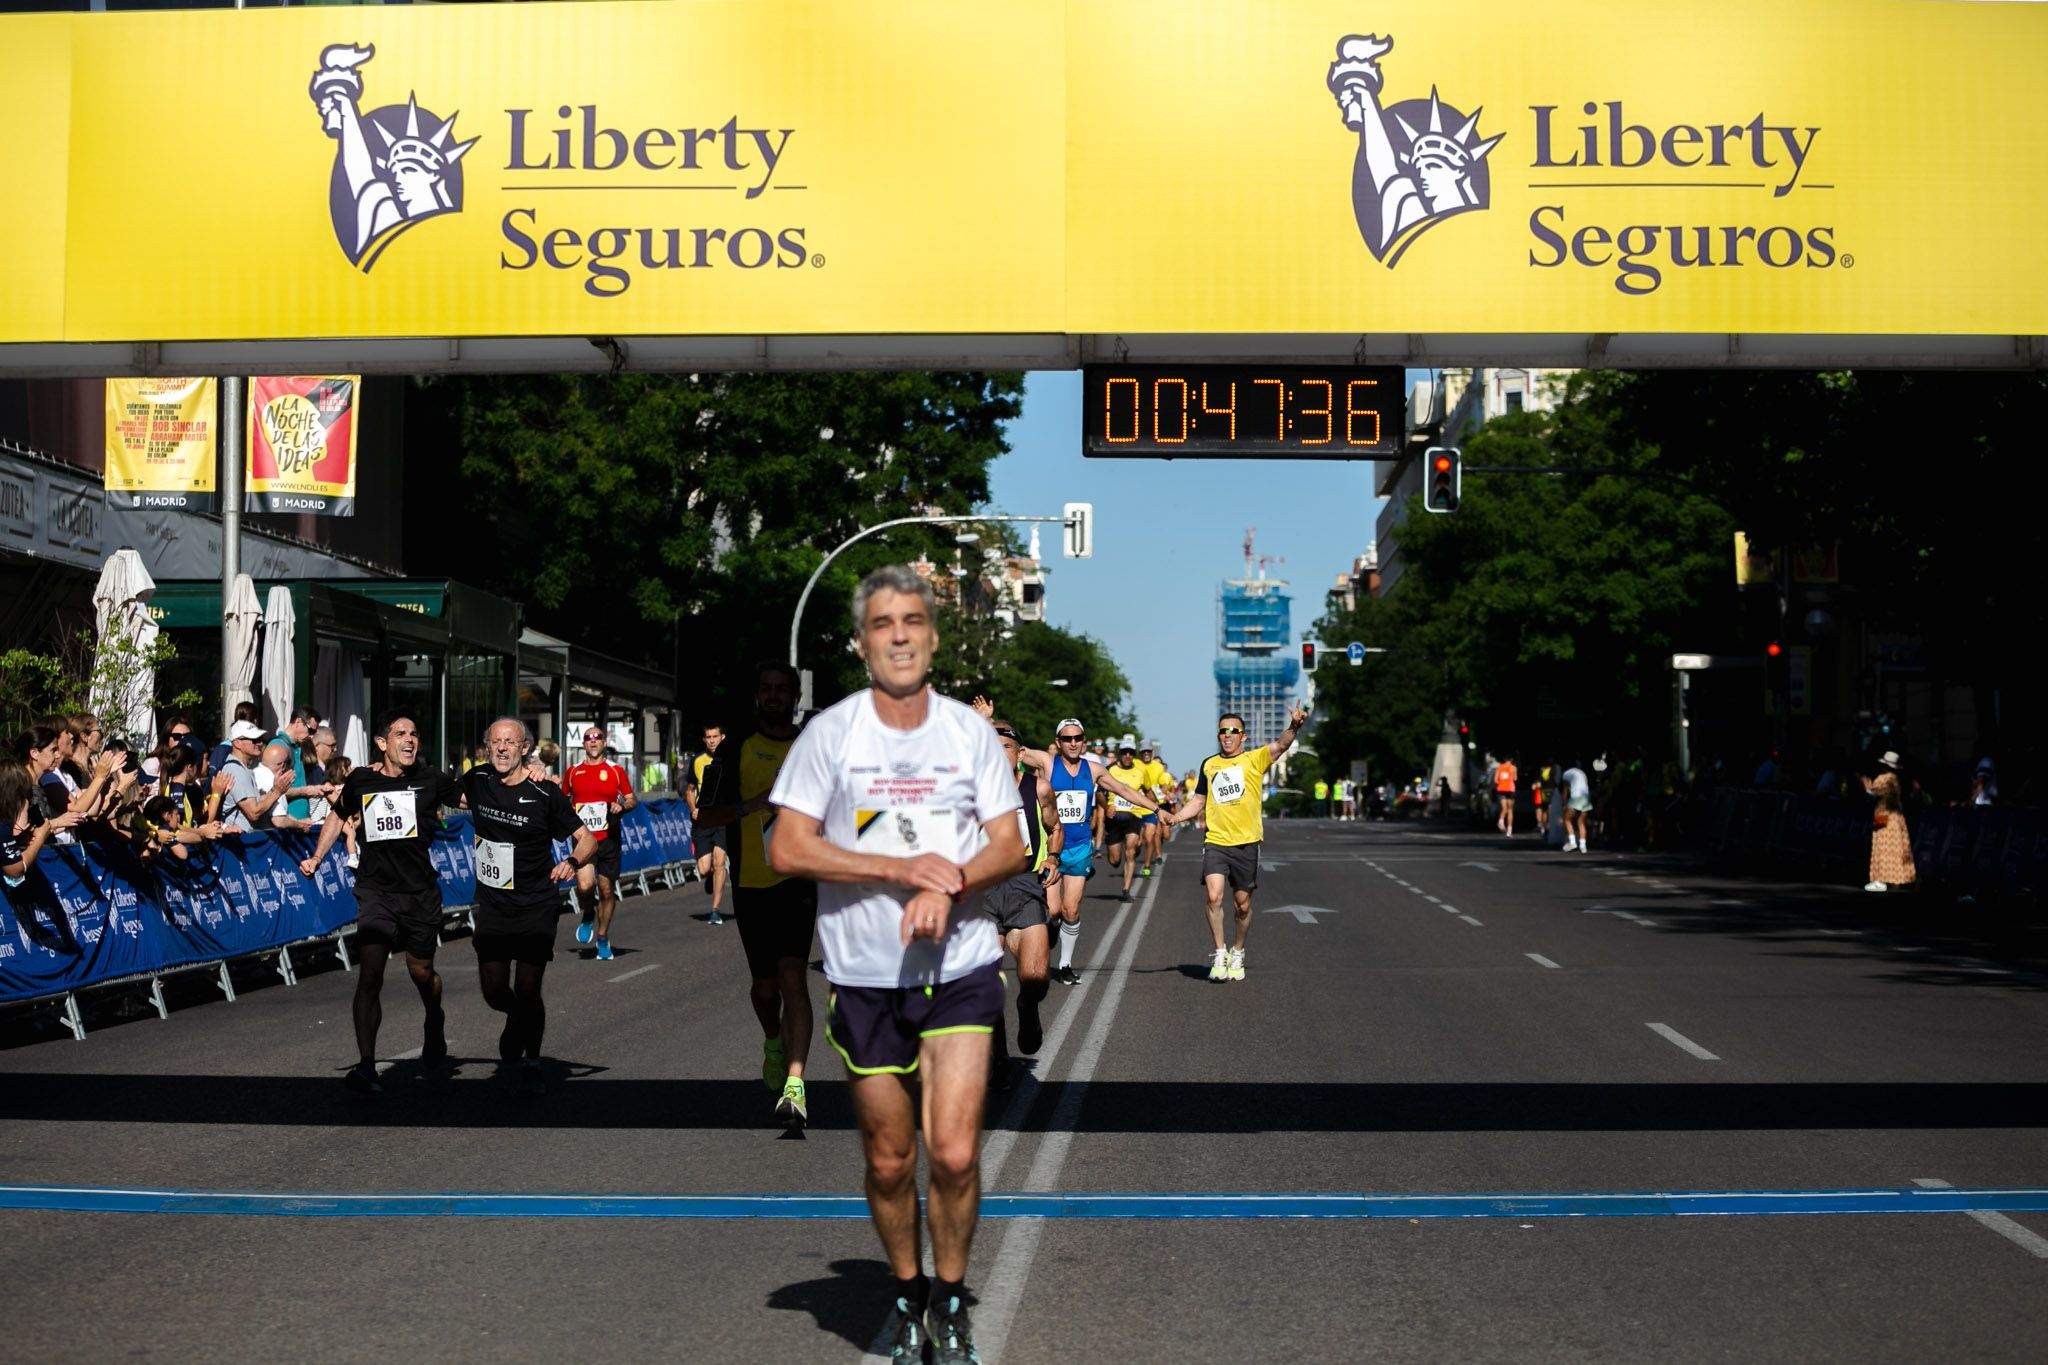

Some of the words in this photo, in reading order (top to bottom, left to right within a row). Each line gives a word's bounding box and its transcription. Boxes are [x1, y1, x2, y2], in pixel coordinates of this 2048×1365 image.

[503, 104, 796, 200] Liberty
[1528, 101, 1821, 197] Liberty
[281, 397, 299, 411] LA
[1105, 378, 1380, 444] 00:47:36
[265, 403, 316, 430] NOCHE
[152, 421, 169, 431] BOB
[171, 421, 207, 432] SINCLAR
[151, 433, 183, 441] ABRAHAM
[272, 430, 291, 444] DE
[293, 431, 321, 448] LAS
[278, 446, 324, 474] IDEAS
[145, 497, 187, 507] MADRID
[285, 498, 326, 510] MADRID
[1217, 783, 1240, 797] 3588
[1058, 807, 1082, 818] 3589
[376, 815, 403, 832] 588
[481, 862, 500, 880] 589
